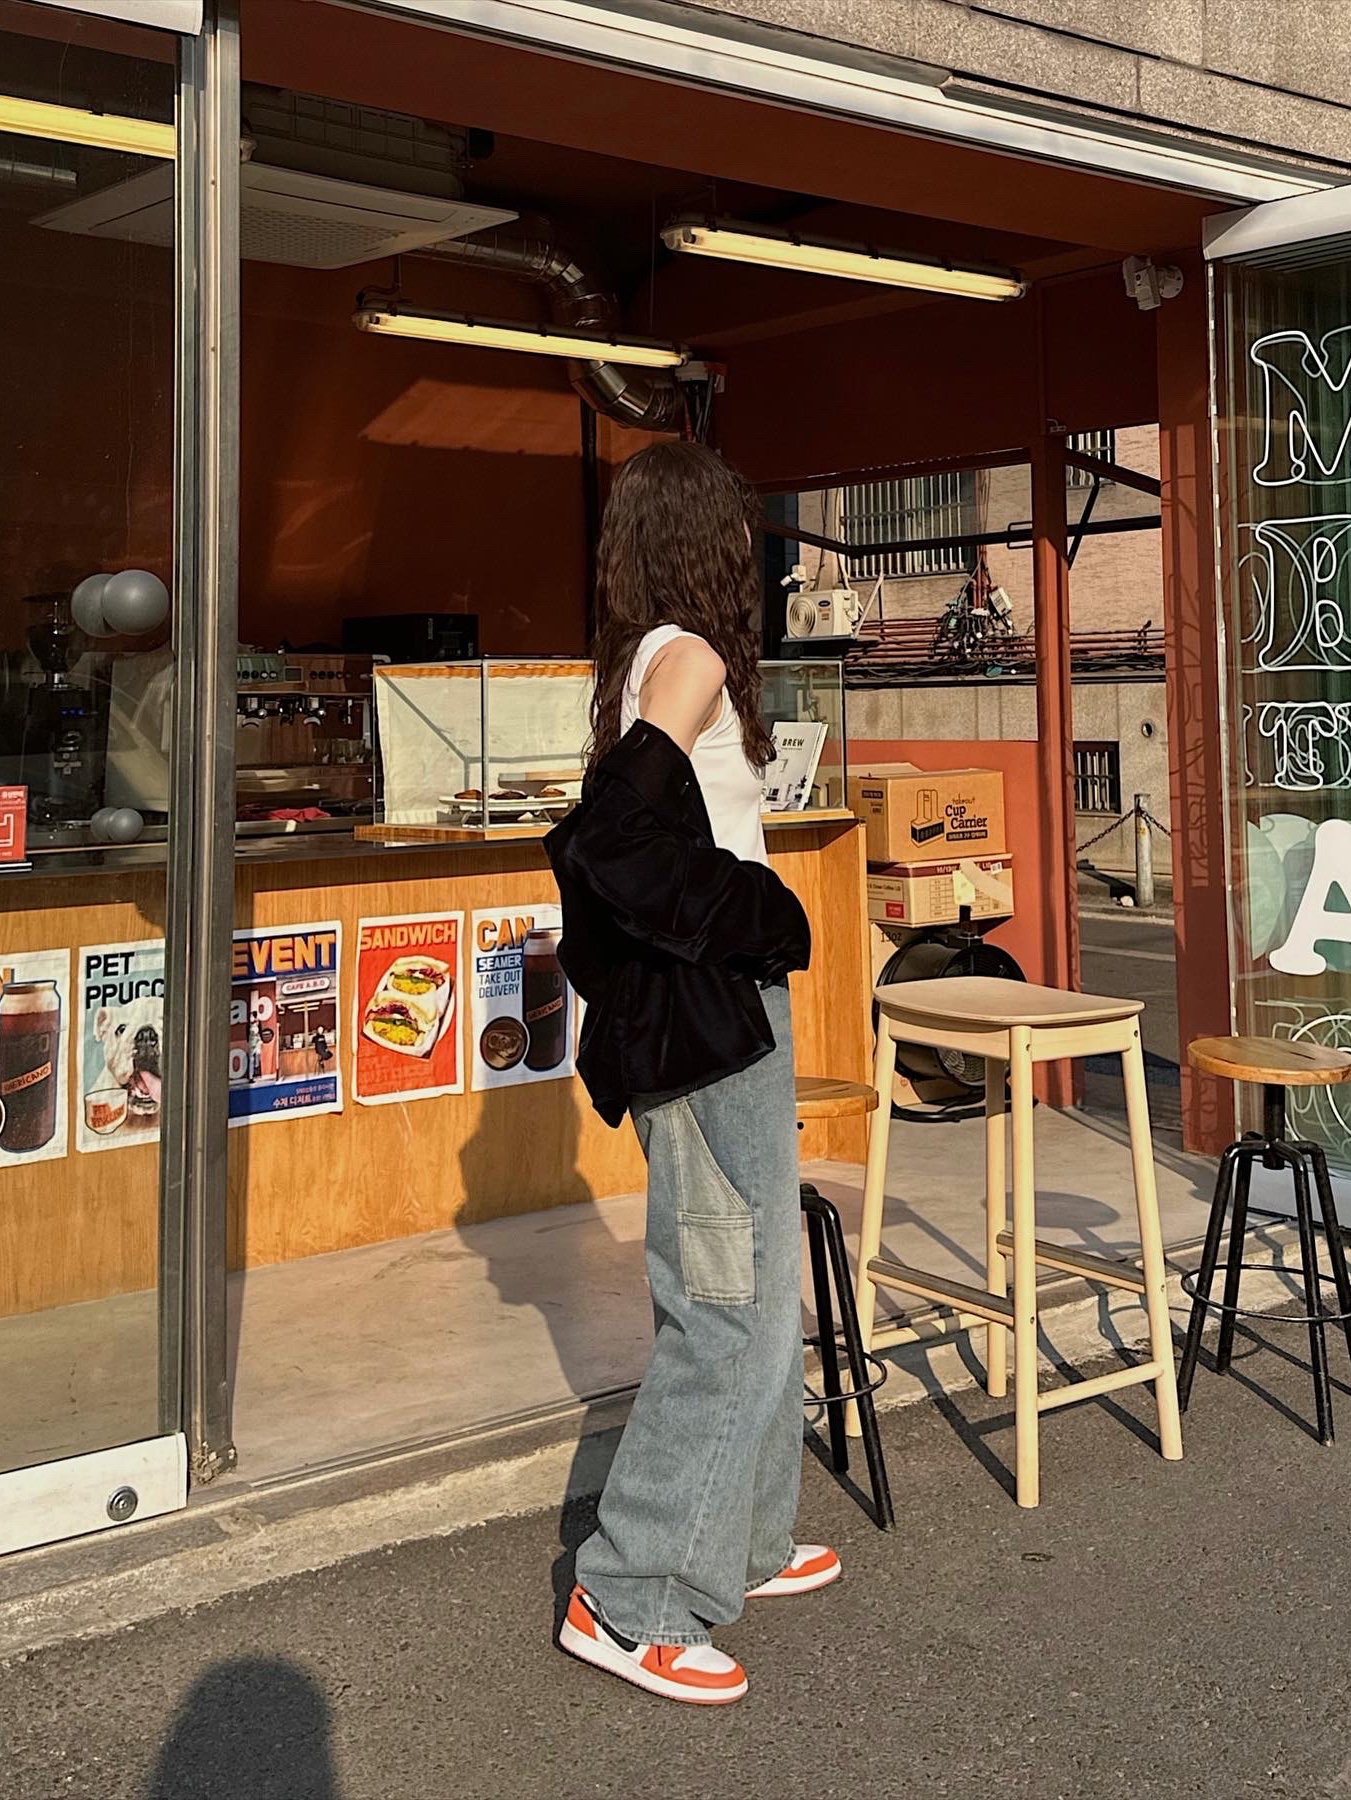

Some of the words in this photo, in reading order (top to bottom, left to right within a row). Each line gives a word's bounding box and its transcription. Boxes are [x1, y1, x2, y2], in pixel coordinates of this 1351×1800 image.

[782, 738, 805, 747] BREW
[945, 804, 966, 818] Cup
[951, 814, 988, 830] Carrier
[1269, 819, 1351, 976] A
[360, 923, 456, 950] SANDWICH
[477, 916, 534, 952] CAN
[231, 933, 335, 976] EVENT
[478, 954, 522, 972] SEAMER
[86, 952, 135, 979] PET
[479, 971, 501, 985] TAKE
[504, 969, 521, 983] OUT
[479, 984, 520, 999] DELIVERY
